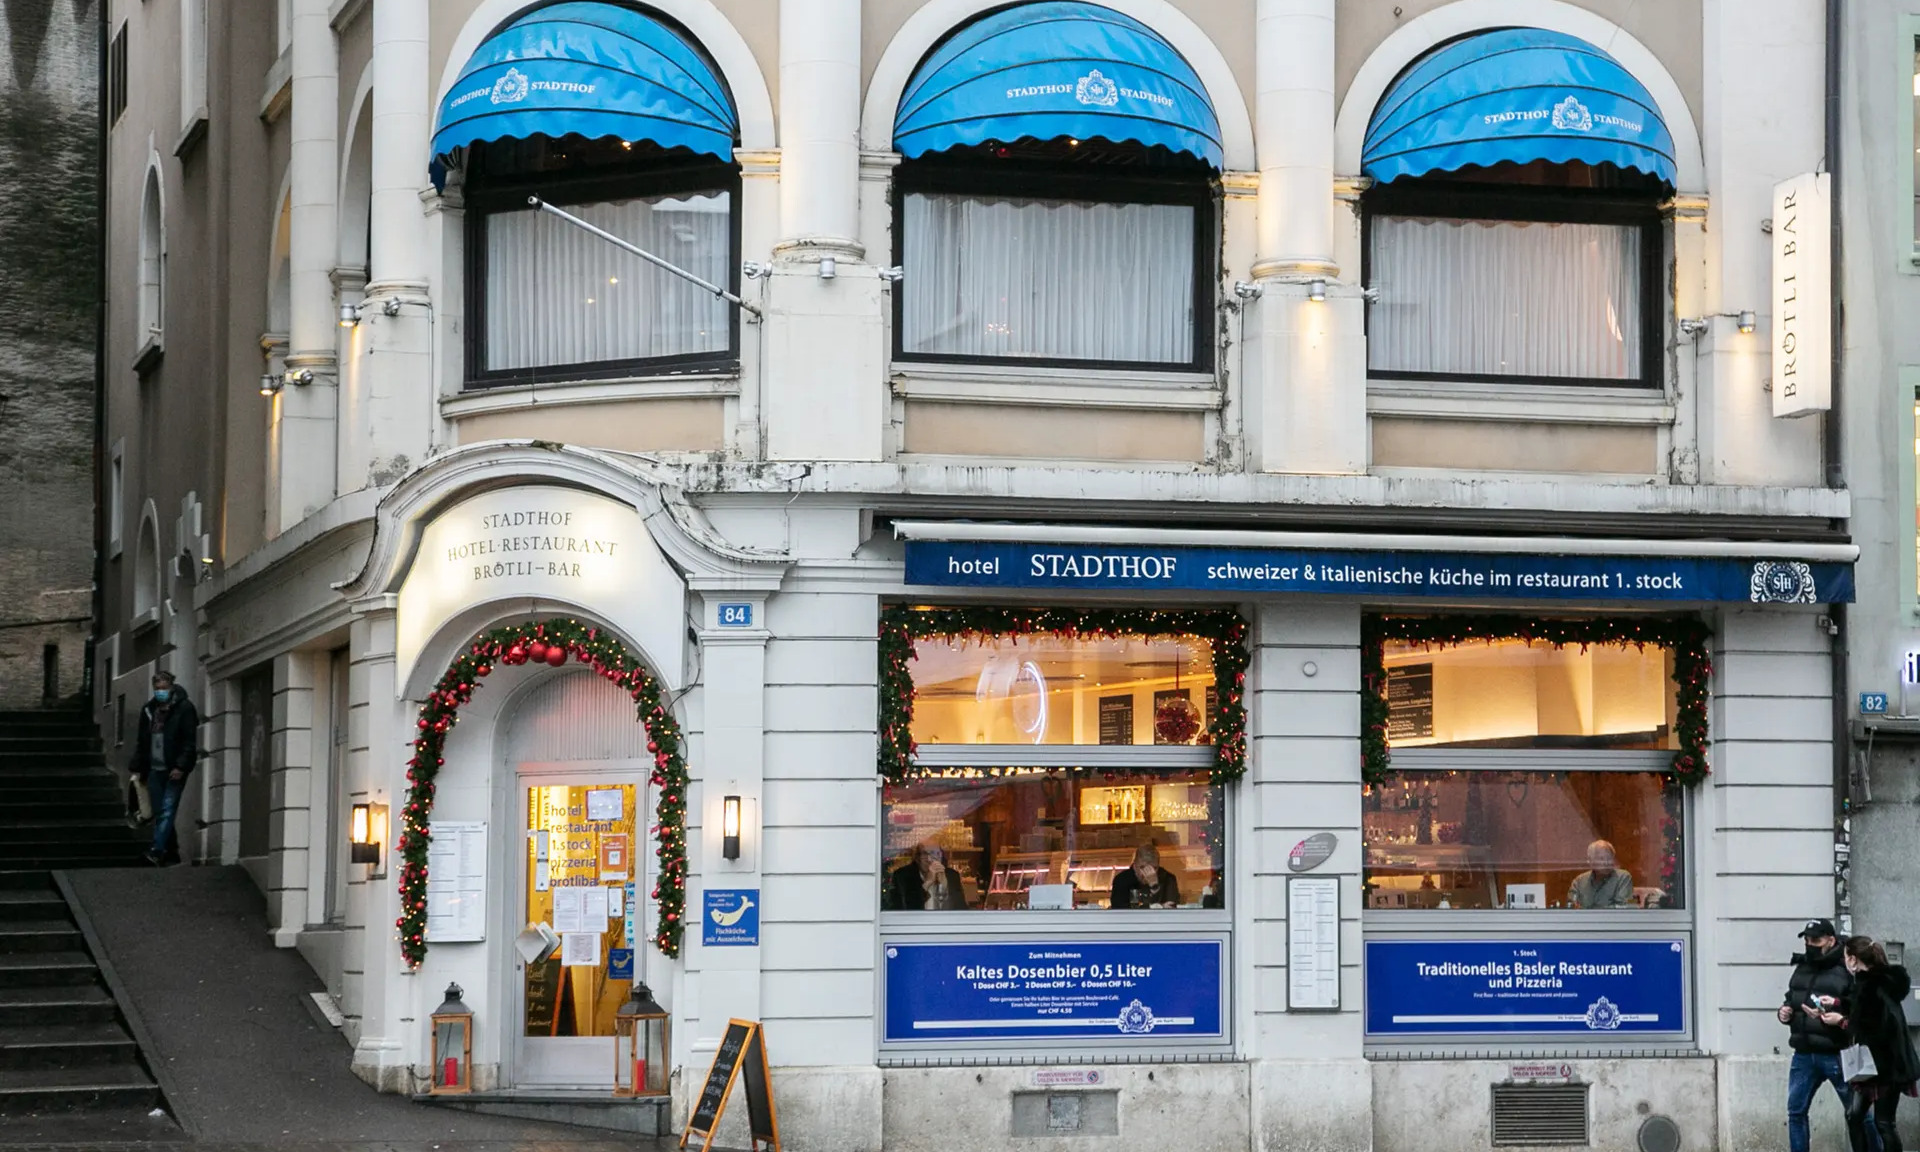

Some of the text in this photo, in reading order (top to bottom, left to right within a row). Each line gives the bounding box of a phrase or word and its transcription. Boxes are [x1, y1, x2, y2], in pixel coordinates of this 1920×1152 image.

[531, 81, 597, 94] STADTHOF
[1006, 84, 1073, 99] STADTHOF
[450, 86, 492, 110] STADTHOF
[1120, 87, 1175, 107] STADTHOF
[1484, 110, 1550, 125] STADTHOF
[1593, 114, 1643, 133] STADTHOF
[1783, 190, 1797, 257] BAR
[483, 511, 573, 529] STADTHOF
[949, 554, 1683, 590] hotel STADTHOF schweizer & italienische küche im restaurant 1. stock
[725, 607, 745, 623] 84
[1866, 696, 1883, 710] 82
[551, 804, 582, 817] hotel
[551, 822, 613, 833] restaurant
[551, 856, 597, 869] pizzeria
[1520, 949, 1537, 957] Stock
[956, 963, 1153, 980] Kaltes Dosenbier 0,5 Liter
[1417, 961, 1633, 976] Traditionelles Basler Restaurant
[1030, 981, 1051, 989] Dosen
[1108, 980, 1121, 988] CHF
[1488, 976, 1563, 988] und Pizzeria
